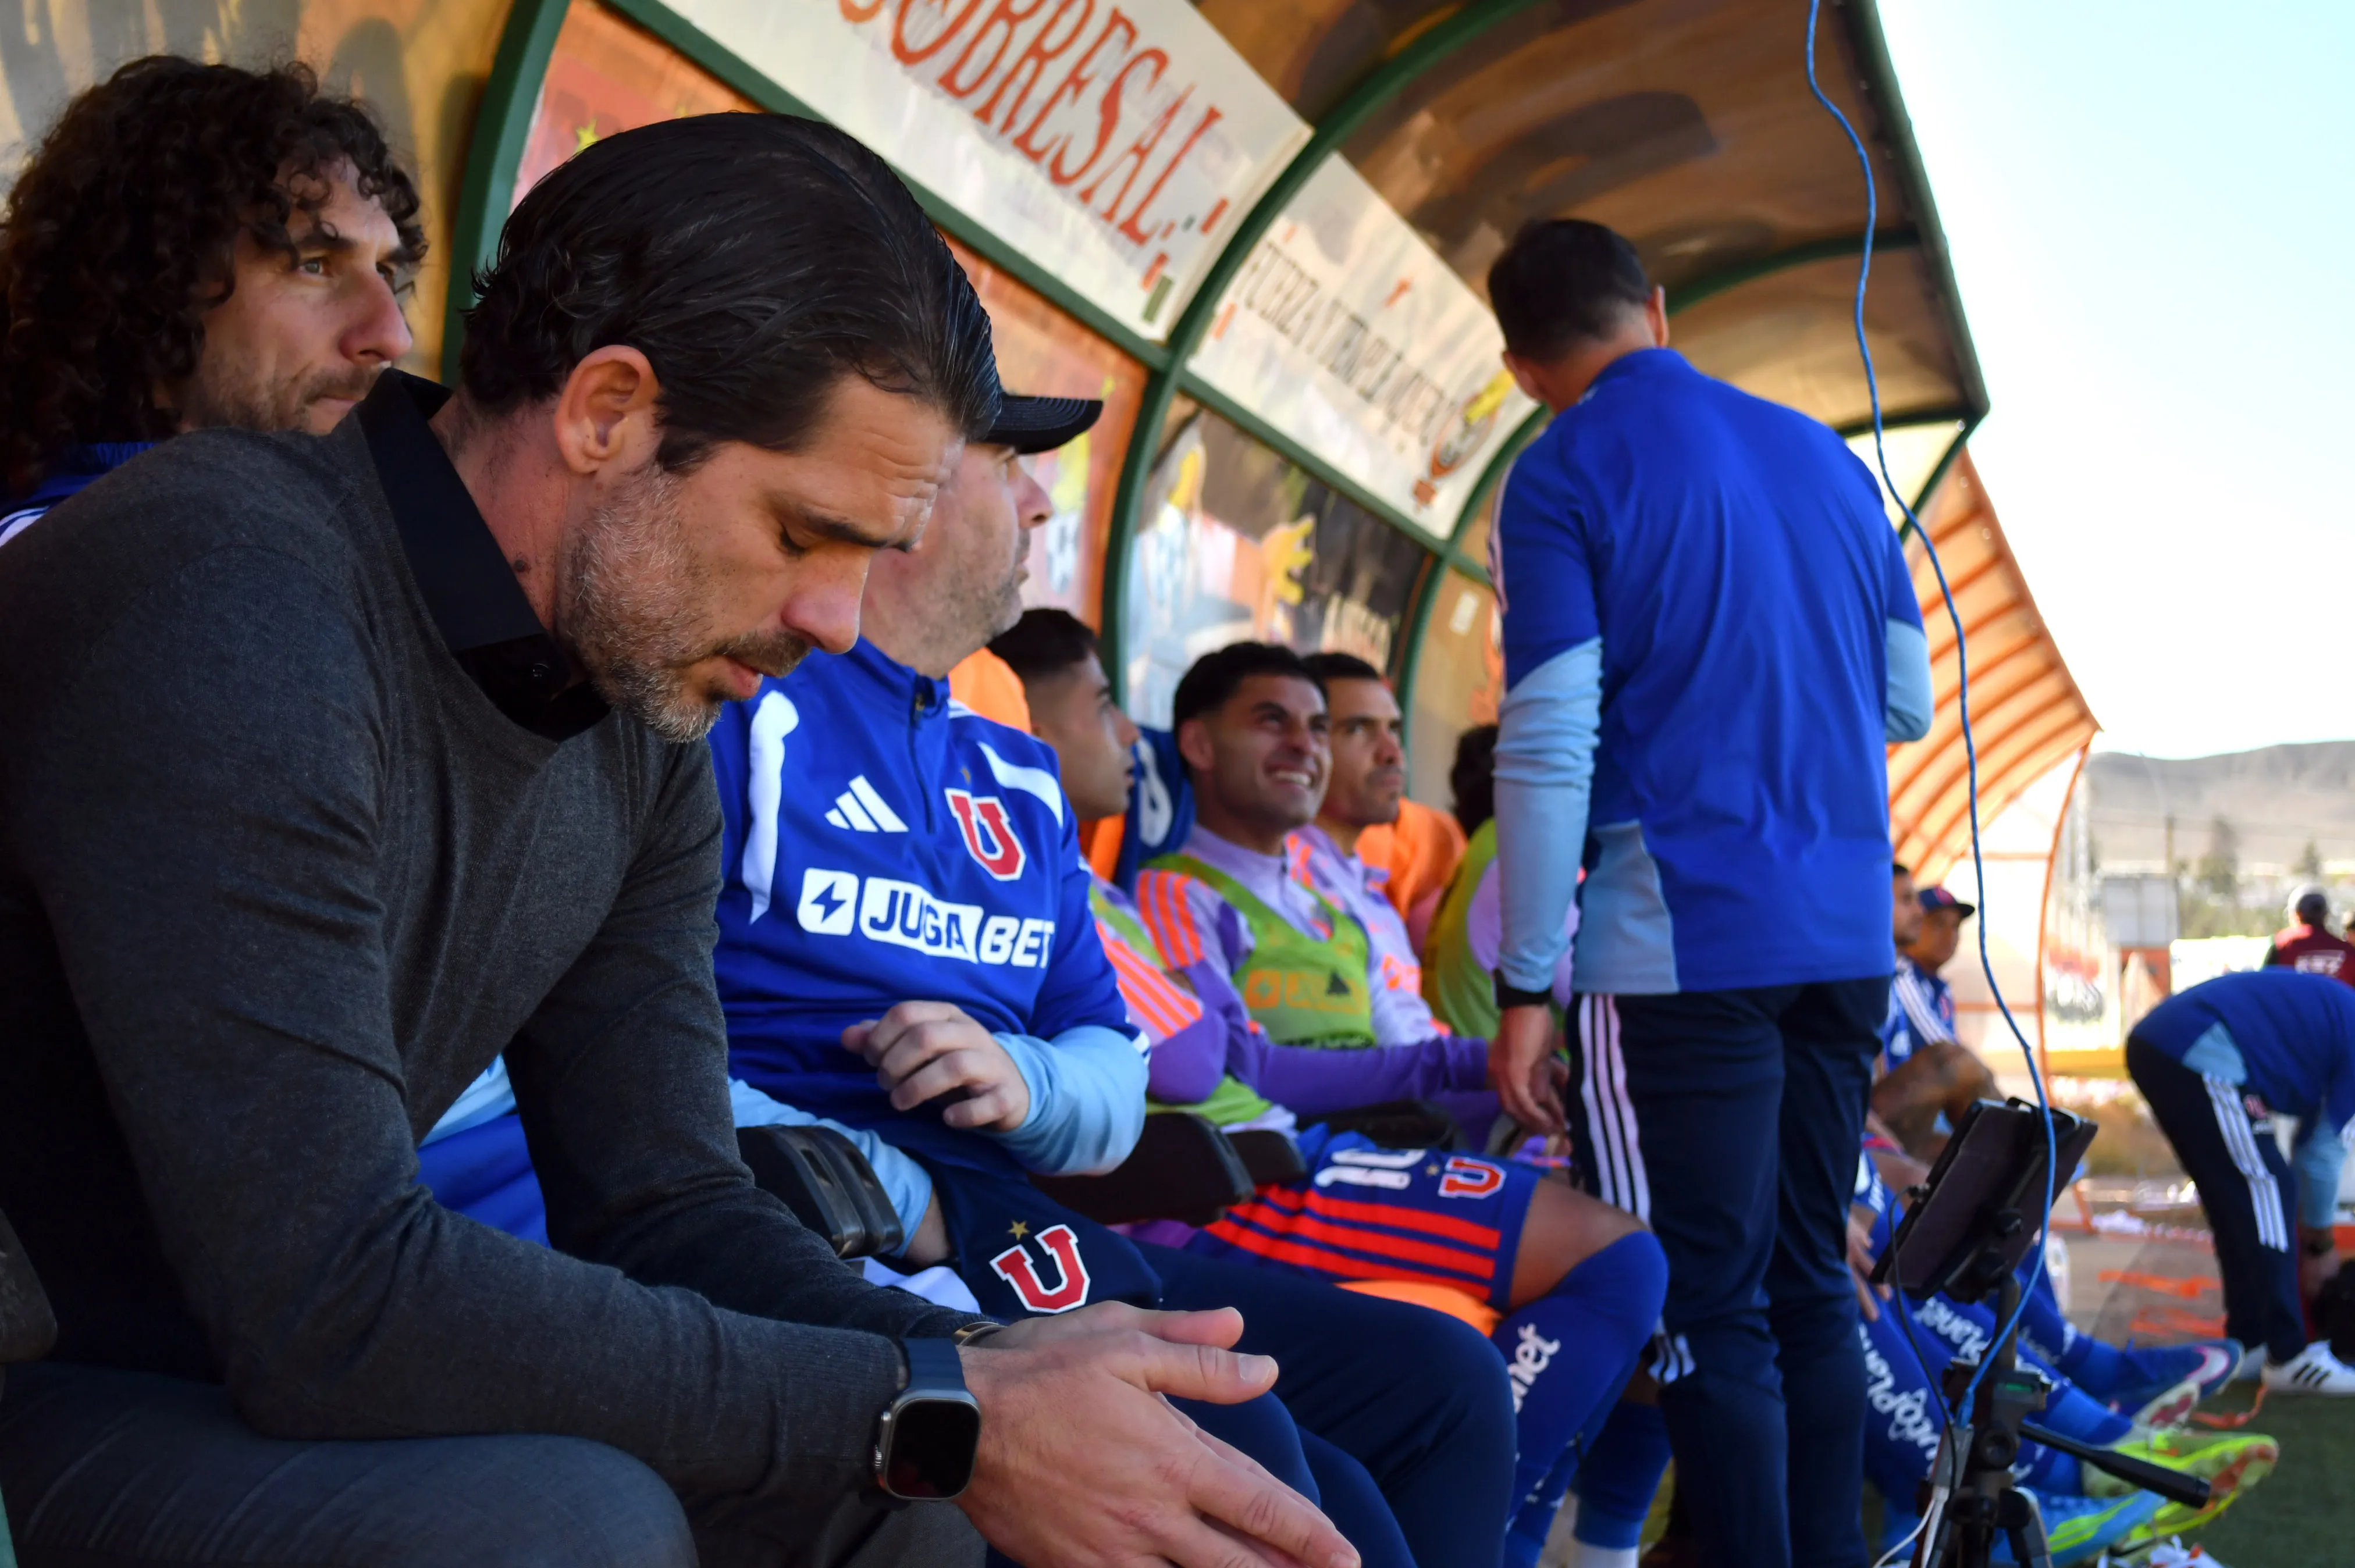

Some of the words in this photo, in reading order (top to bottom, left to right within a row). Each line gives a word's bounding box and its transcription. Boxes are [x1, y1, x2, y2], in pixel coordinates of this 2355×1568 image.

[838, 0, 1223, 247] BRESAL
[944, 787, 1027, 881] U
[1438, 1156, 1507, 1199] U
[990, 1224, 1091, 1314] U
